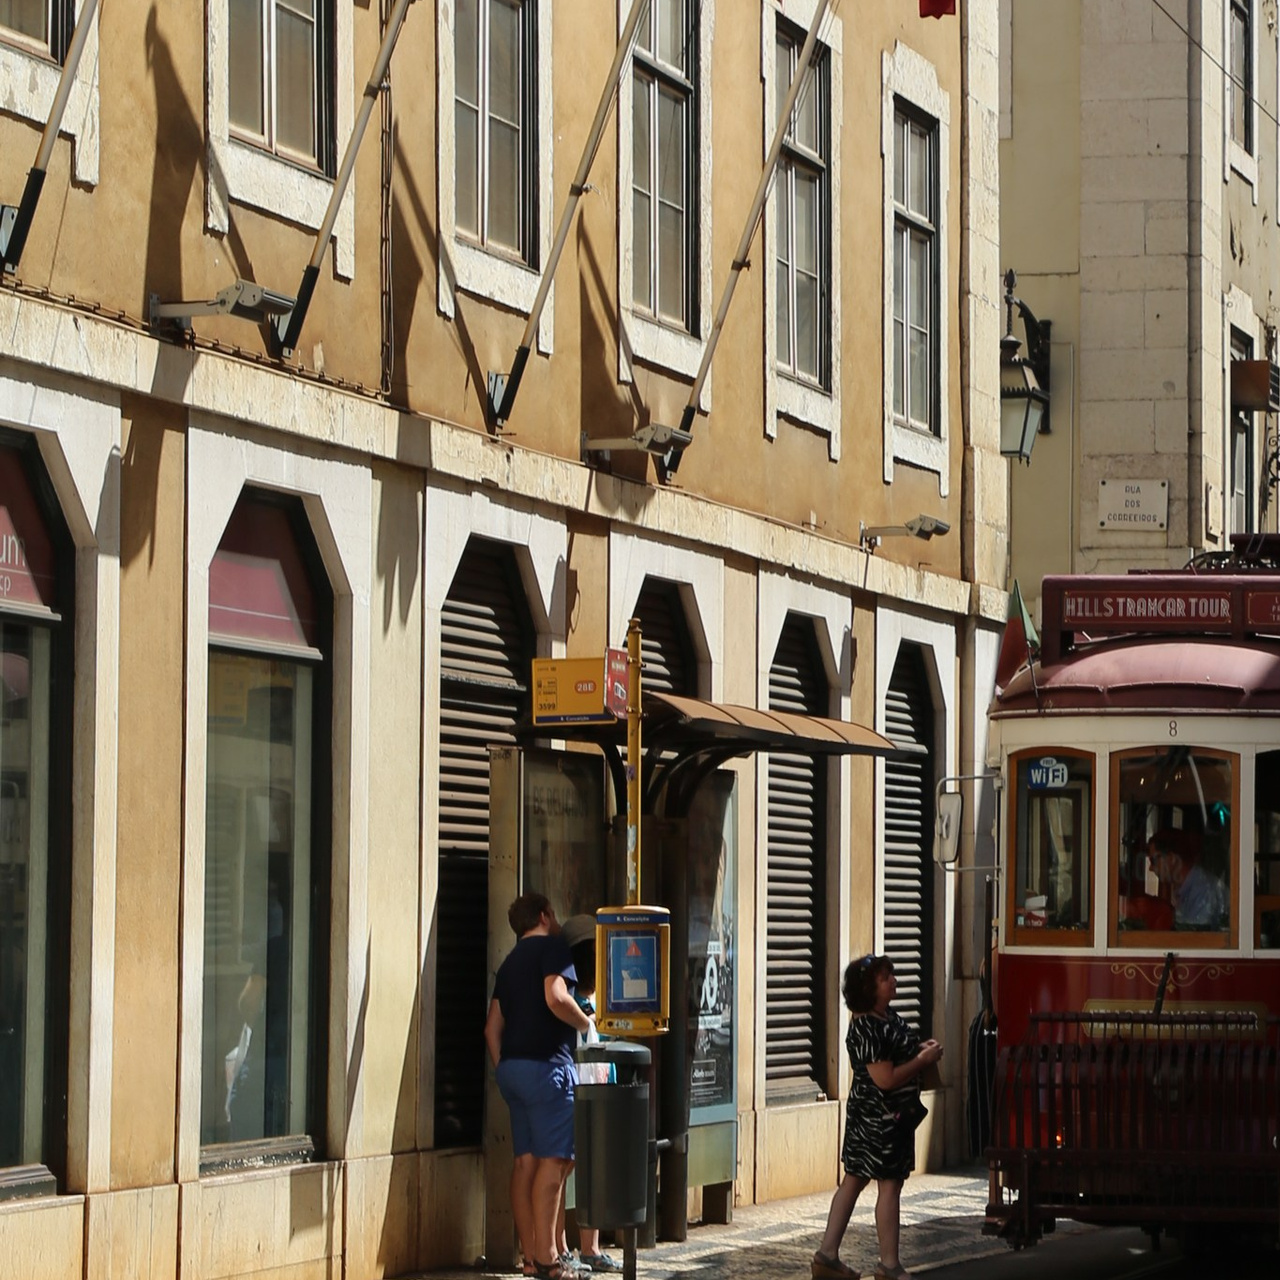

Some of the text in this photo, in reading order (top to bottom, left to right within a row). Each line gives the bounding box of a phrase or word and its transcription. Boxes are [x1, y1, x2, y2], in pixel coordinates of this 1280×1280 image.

[1124, 485, 1142, 494] RUA
[1124, 500, 1141, 508] DOS
[1107, 513, 1158, 522] CORREEIROS
[1065, 597, 1231, 618] HILLS TRAMCAR TOUR
[577, 682, 594, 692] 28E
[1168, 720, 1178, 737] 8
[1031, 766, 1065, 784] WiFi
